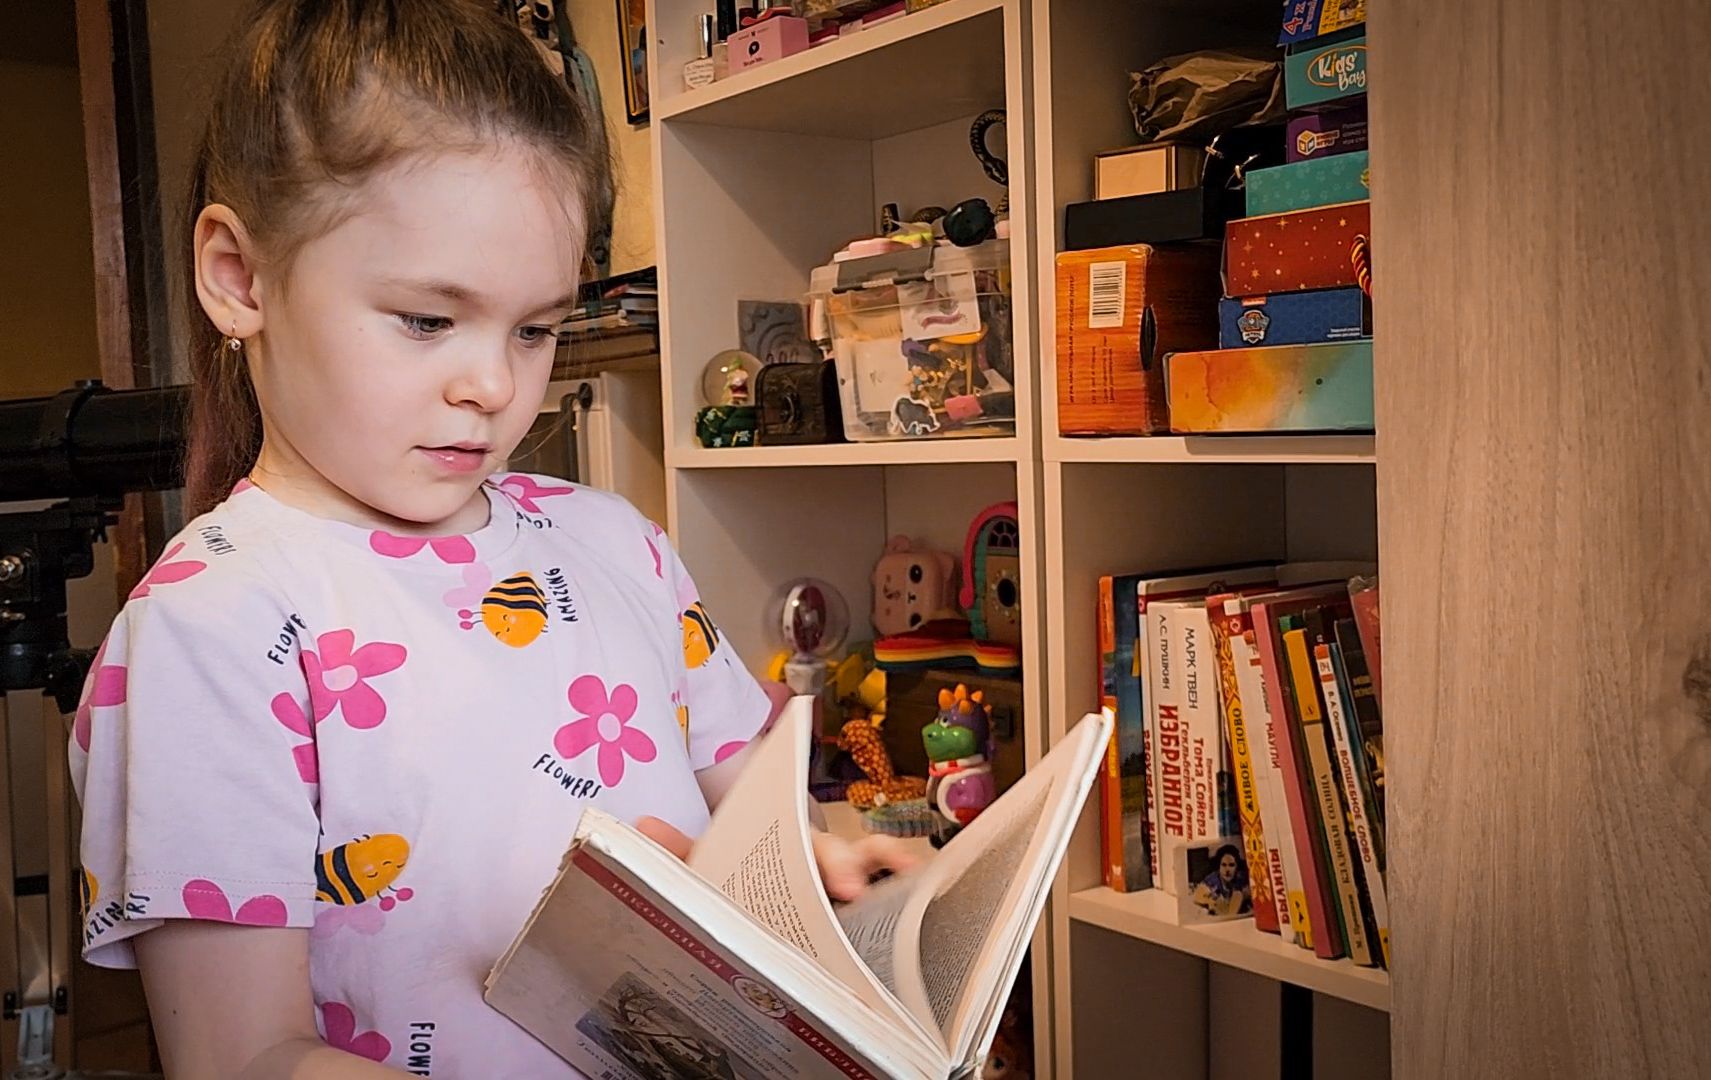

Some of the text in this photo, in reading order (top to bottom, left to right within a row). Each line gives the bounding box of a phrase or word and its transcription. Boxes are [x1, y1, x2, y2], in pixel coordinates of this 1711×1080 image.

[1160, 639, 1170, 690] ПУШКИН
[1185, 627, 1198, 709] МАРК ТВЕН
[532, 753, 602, 800] FLOWERS
[1159, 704, 1184, 837] ИЗБРАННОЕ
[1193, 737, 1207, 837] Тома Сойера
[1232, 707, 1255, 812] ЖИВОЕ СЛОВО
[1340, 749, 1362, 821] ВОЛШЕБНОЕ
[1356, 825, 1371, 863] СЛОВО
[611, 881, 723, 970] ШКОЛЬНАЯ
[1269, 848, 1290, 925] БЫЛИНЫ
